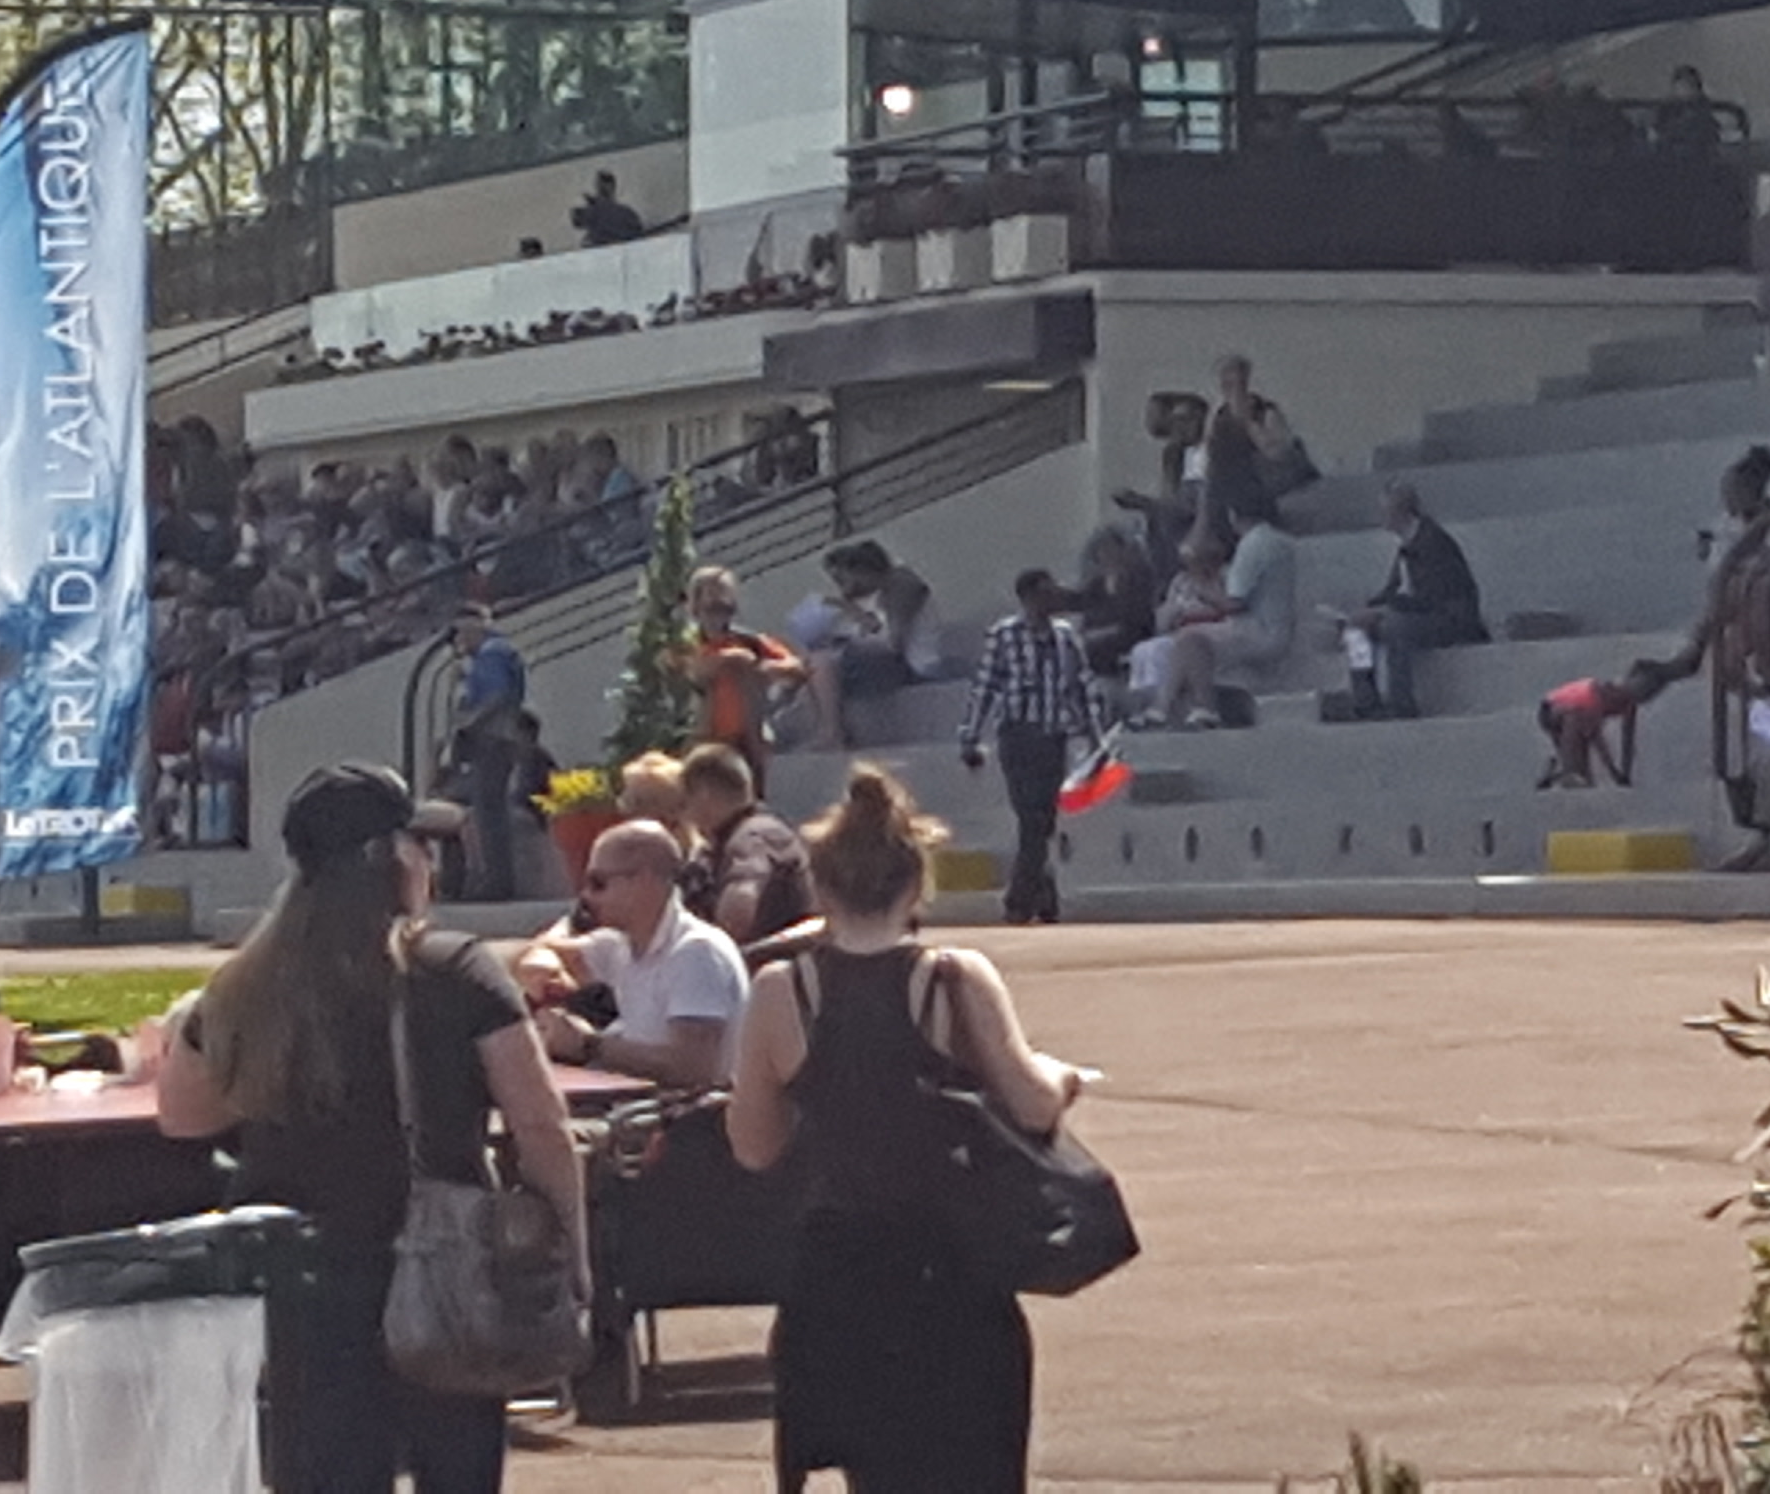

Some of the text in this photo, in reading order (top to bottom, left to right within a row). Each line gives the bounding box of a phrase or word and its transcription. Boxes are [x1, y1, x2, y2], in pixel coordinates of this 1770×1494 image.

[38, 81, 100, 768] PRIX DE L'ATLANTIQUE
